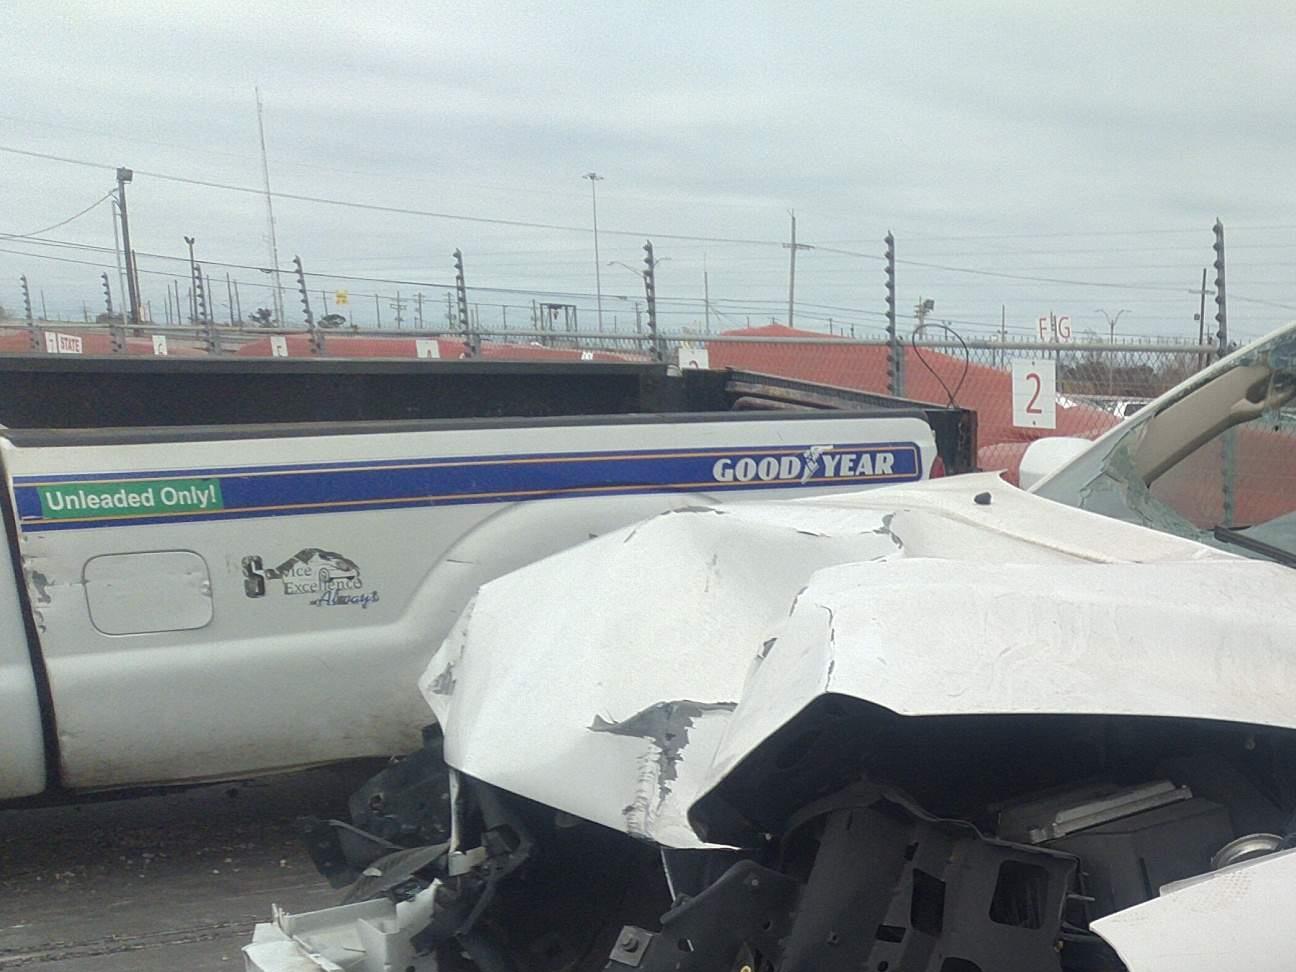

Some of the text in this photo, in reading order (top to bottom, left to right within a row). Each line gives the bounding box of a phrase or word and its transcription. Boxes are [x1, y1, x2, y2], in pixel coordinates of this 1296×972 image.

[60, 337, 80, 351] STATE
[1025, 372, 1042, 414] 2
[45, 484, 217, 511] Unleaded Only!
